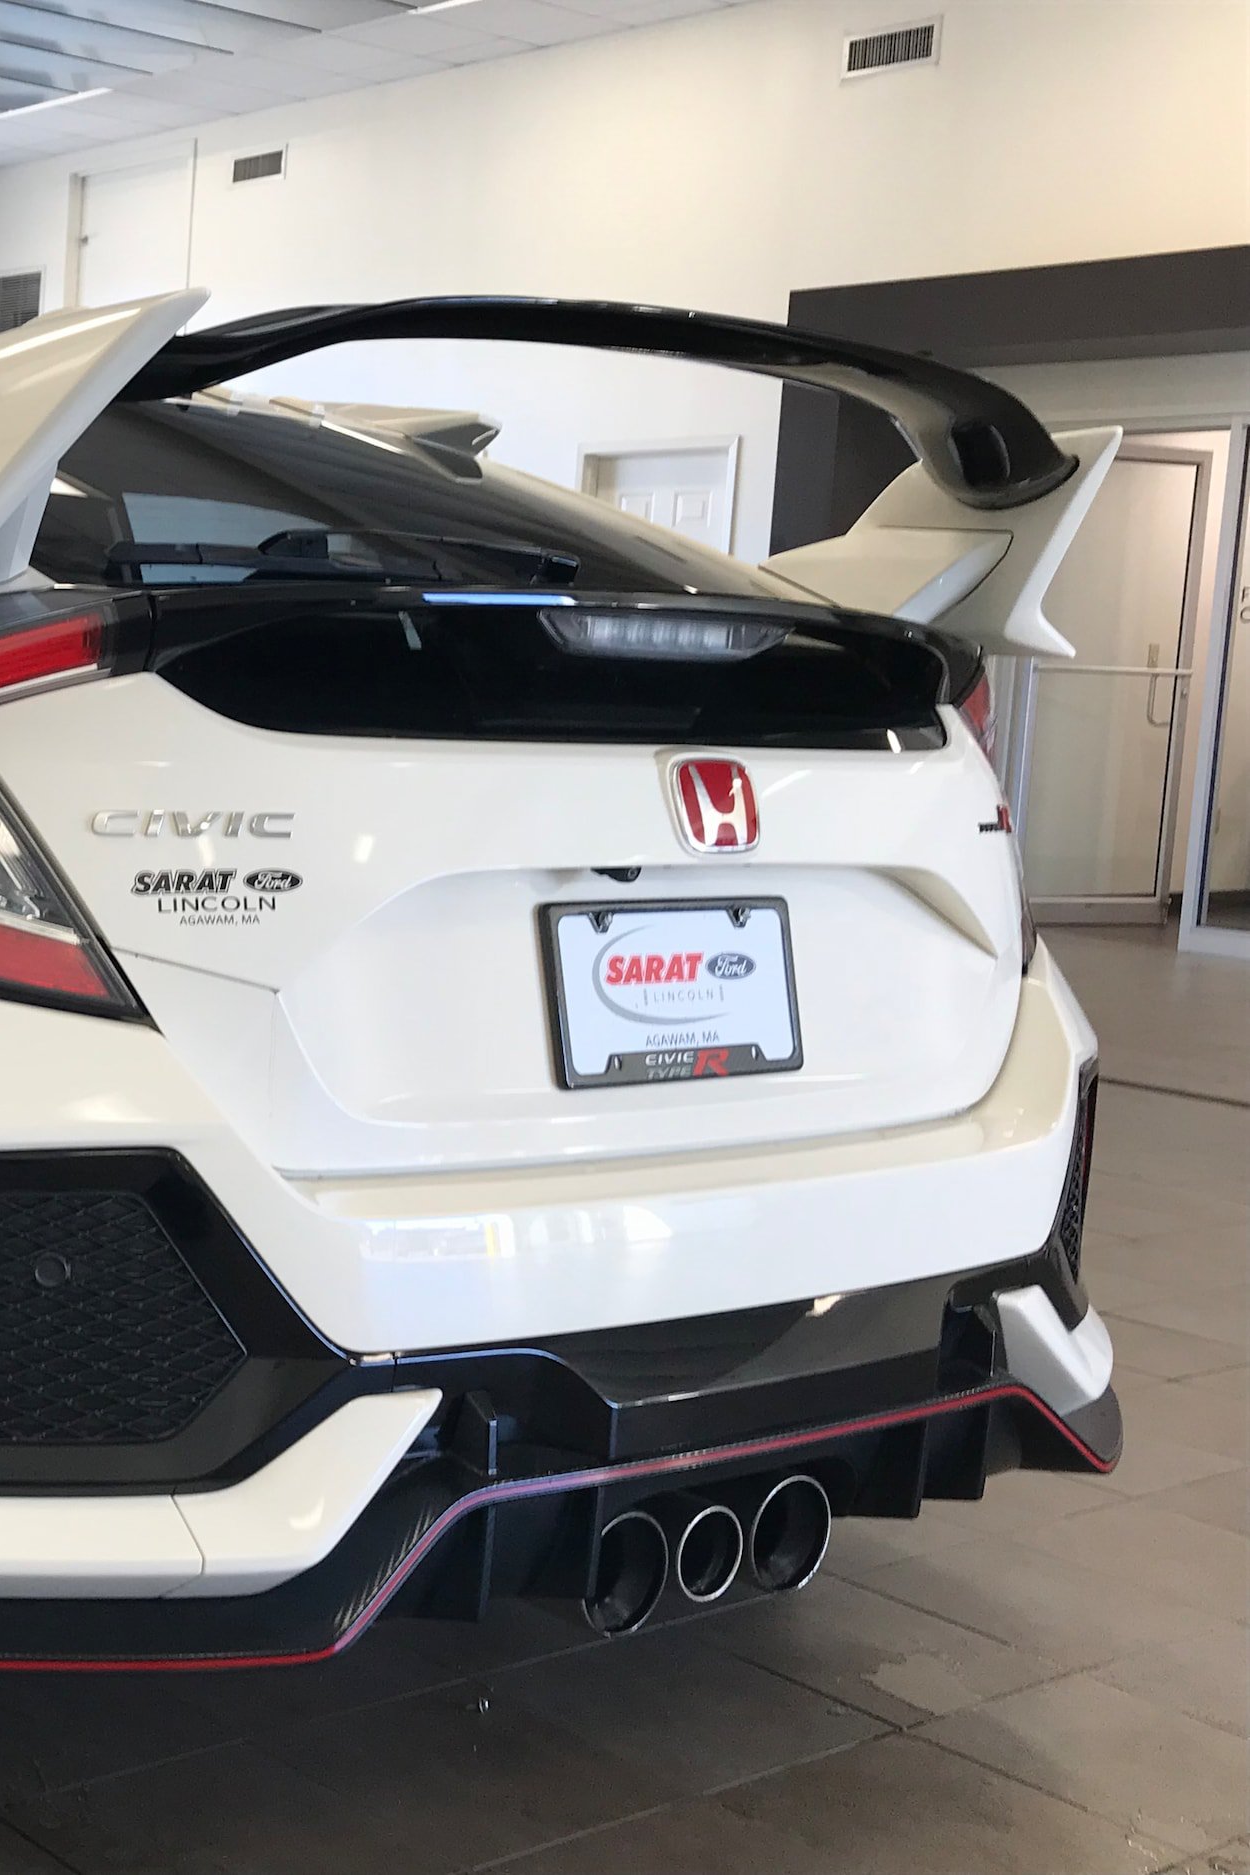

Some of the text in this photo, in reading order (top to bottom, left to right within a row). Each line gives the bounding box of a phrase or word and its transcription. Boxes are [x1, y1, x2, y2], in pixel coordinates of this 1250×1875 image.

[91, 808, 296, 839] CIVIC
[131, 867, 294, 896] SARAT Ford
[156, 896, 277, 914] LINCOLN
[179, 913, 261, 927] AGAWAM, MA
[605, 951, 750, 986] SARAT Ford
[653, 987, 715, 1004] LINCOLN
[645, 1029, 720, 1048] AGAWAM, MA
[644, 1050, 695, 1067] CIVIC
[646, 1046, 730, 1081] TYPE R
